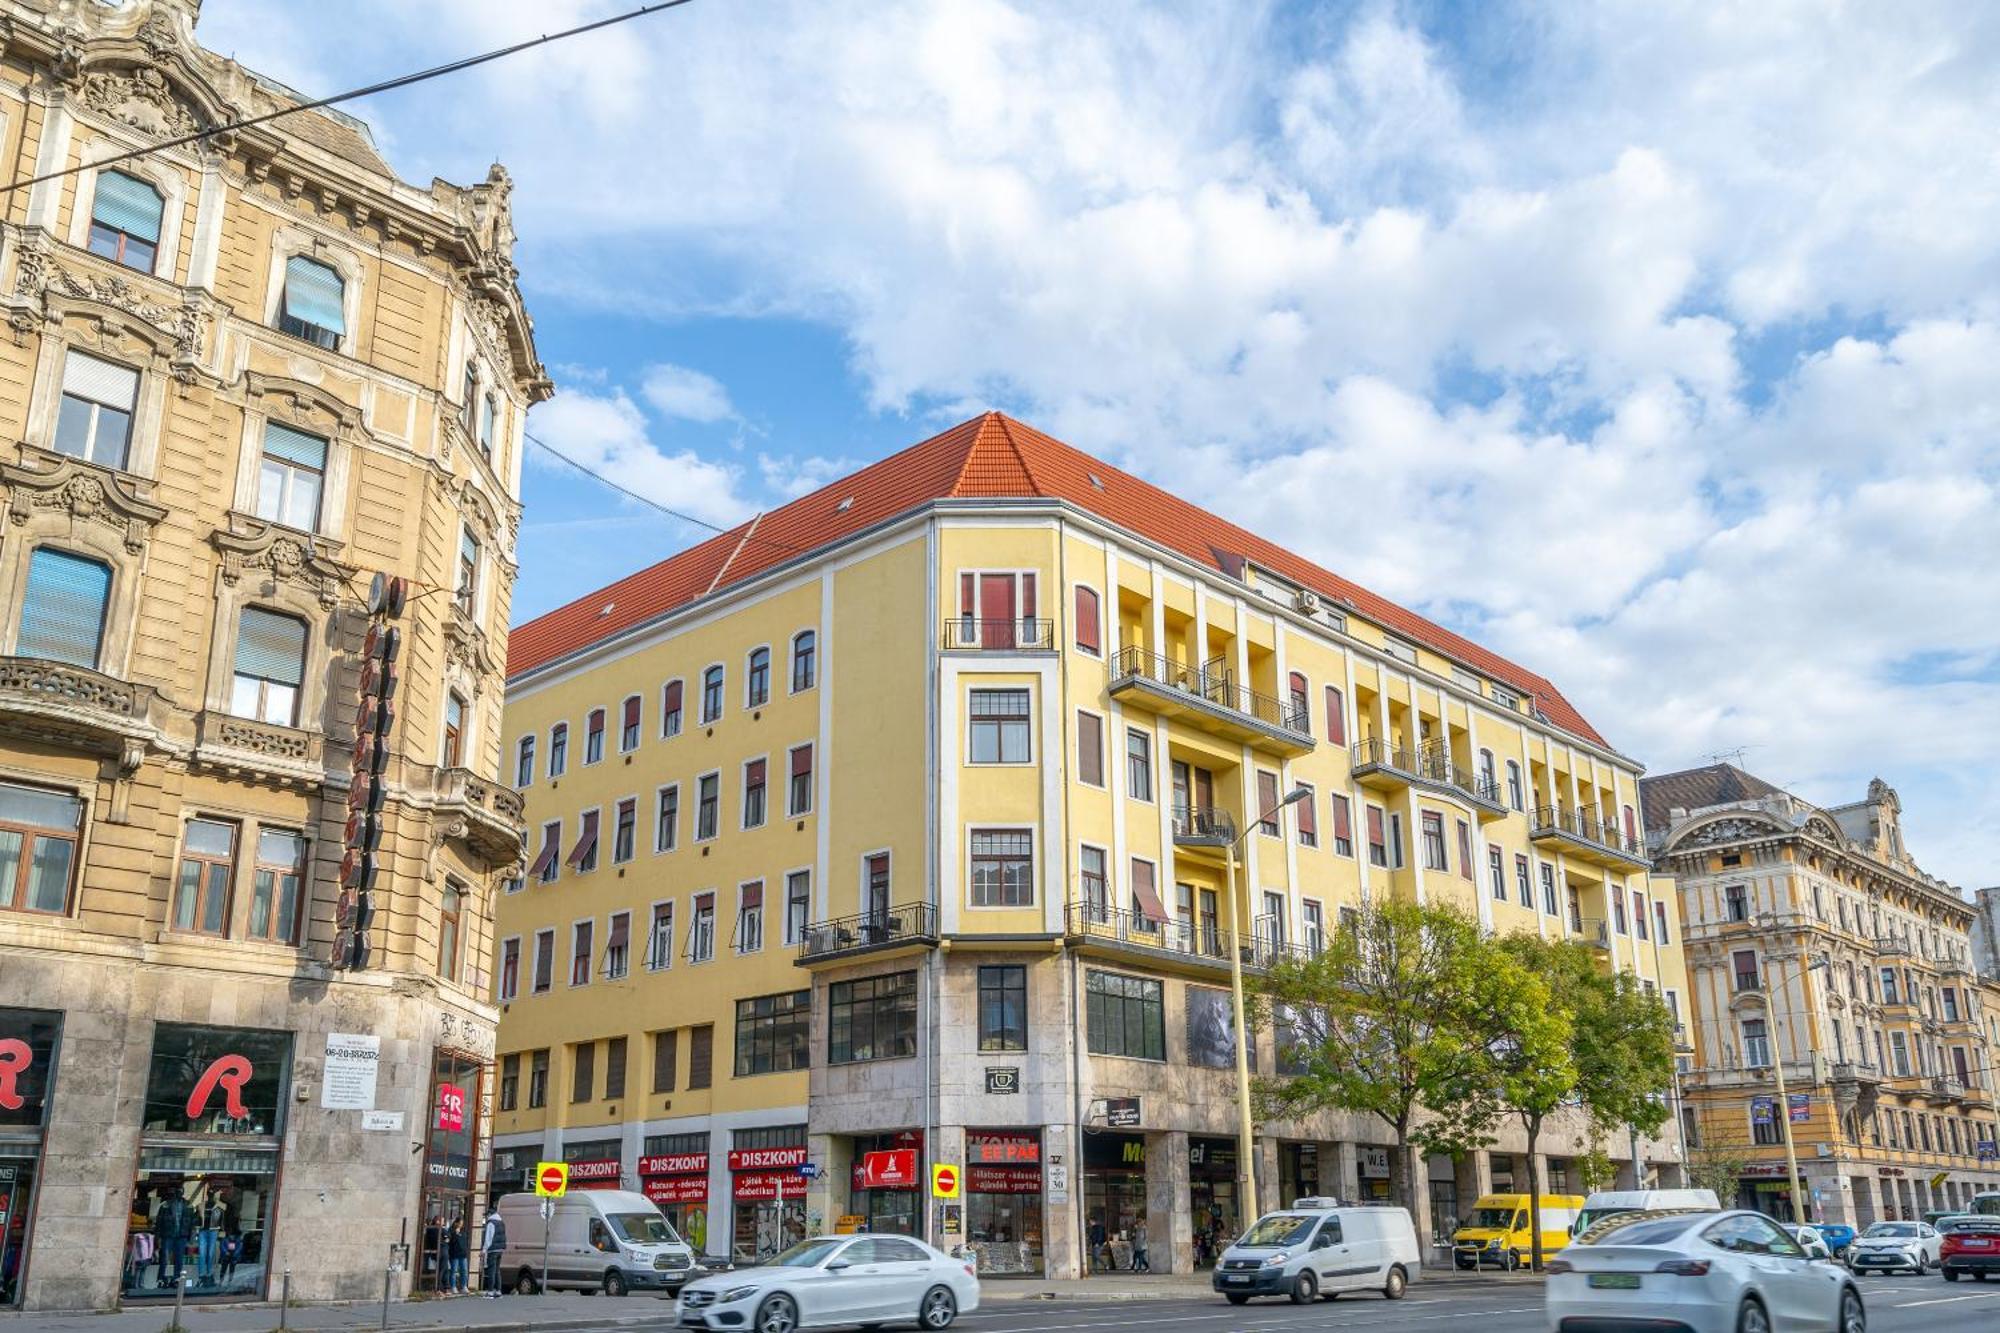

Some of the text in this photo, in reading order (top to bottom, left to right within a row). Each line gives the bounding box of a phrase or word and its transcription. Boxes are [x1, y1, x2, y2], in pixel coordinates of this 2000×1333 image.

[186, 1054, 253, 1119] R
[650, 1156, 707, 1172] DISZKONT
[741, 1150, 806, 1167] DISZKONT
[568, 1161, 619, 1177] DISZKONT
